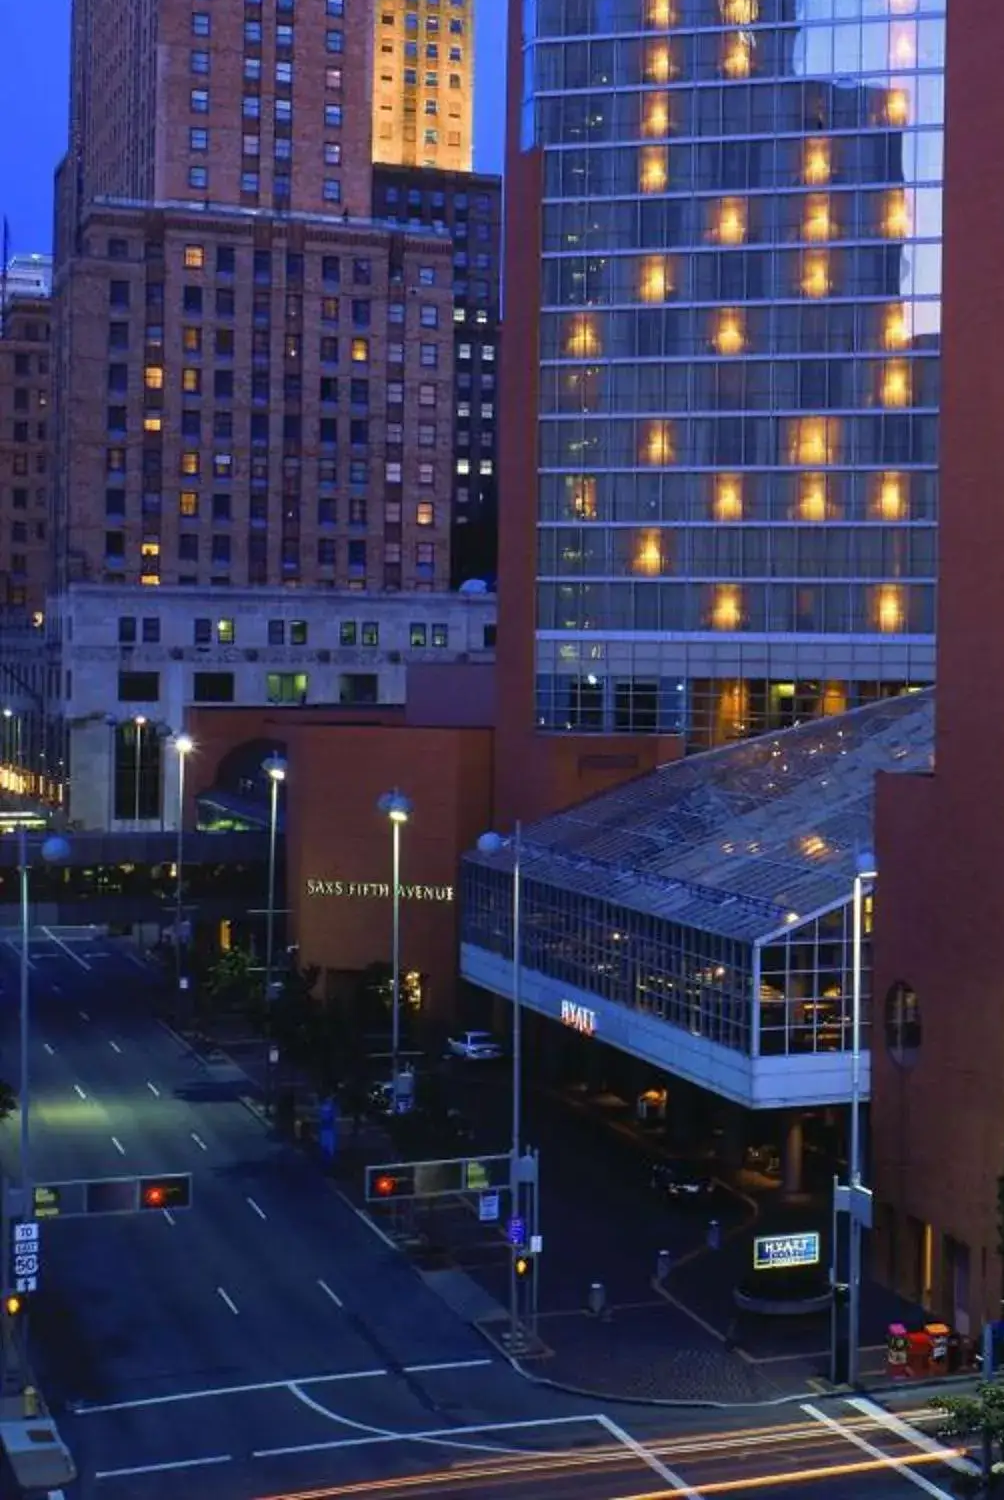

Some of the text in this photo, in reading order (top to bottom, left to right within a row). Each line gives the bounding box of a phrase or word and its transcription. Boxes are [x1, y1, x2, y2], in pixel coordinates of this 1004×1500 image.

[349, 882, 390, 897] FIFTH
[396, 884, 454, 901] AVENUE
[561, 999, 597, 1033] HYATT
